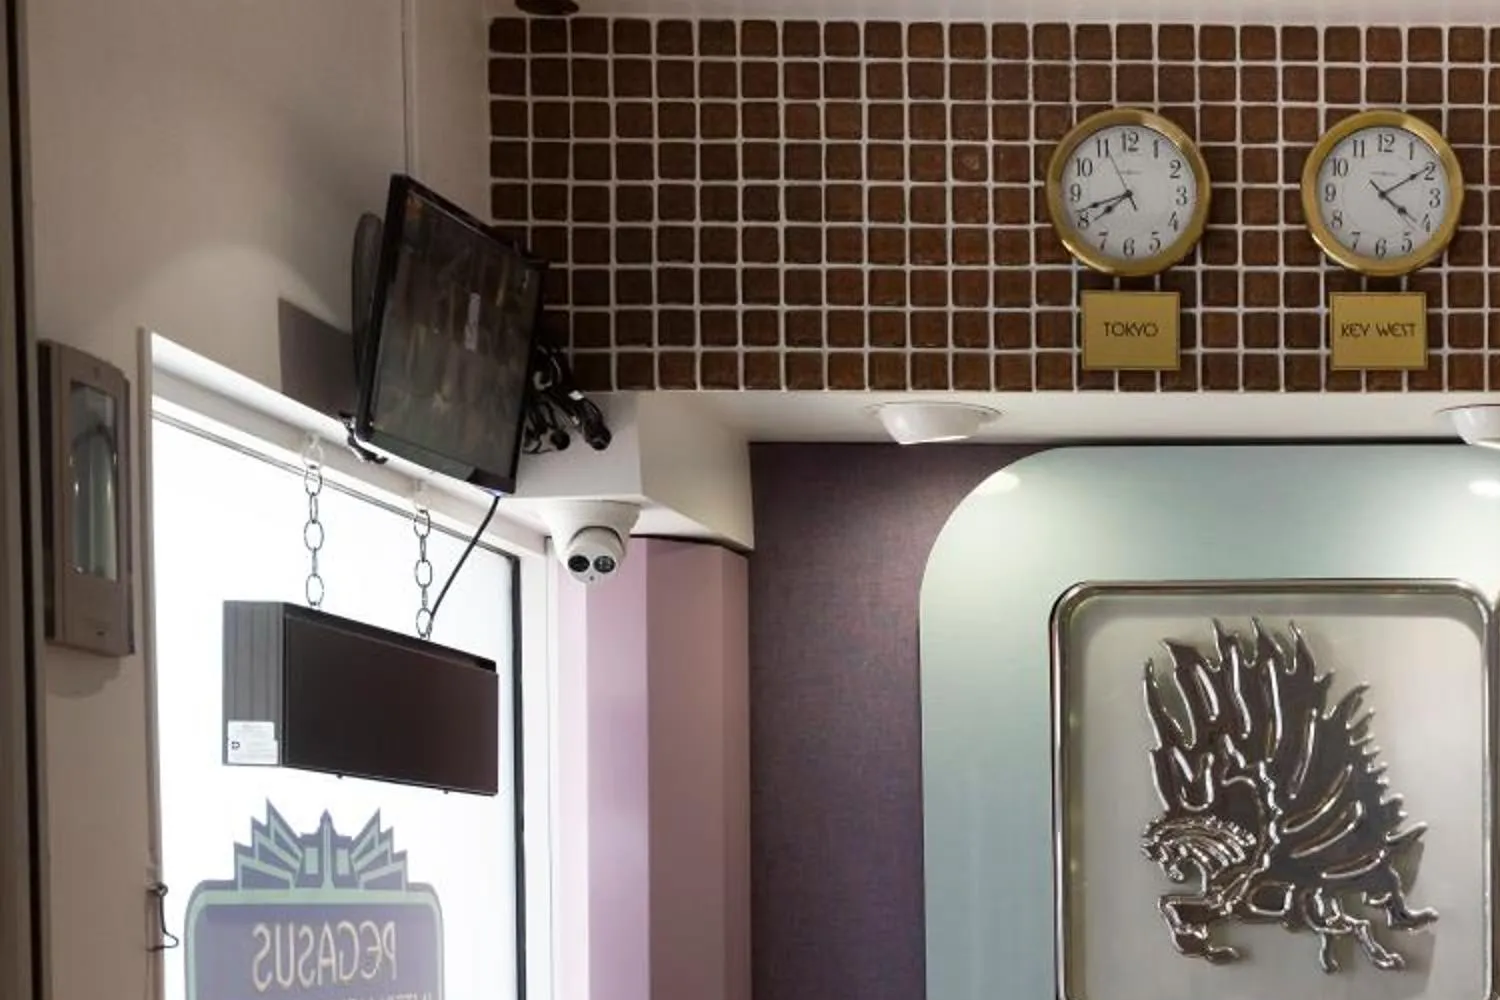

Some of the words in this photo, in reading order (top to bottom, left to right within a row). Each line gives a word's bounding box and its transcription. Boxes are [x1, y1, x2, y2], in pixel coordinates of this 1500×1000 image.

[1097, 138, 1109, 158] 11
[1122, 132, 1138, 152] 12
[1353, 140, 1365, 158] 11
[1378, 134, 1395, 152] 12
[1077, 158, 1093, 177] 10
[1170, 160, 1181, 179] 2
[1332, 158, 1348, 176] 10
[1424, 162, 1436, 181] 2
[1070, 183, 1081, 202] 9
[1176, 186, 1187, 205] 3
[1325, 184, 1336, 202] 9
[1429, 188, 1440, 208] 3
[1078, 211, 1090, 229] 8
[1168, 211, 1178, 231] 4
[1331, 211, 1342, 229] 8
[1422, 214, 1430, 232] 4
[1099, 232, 1108, 250] 7
[1123, 237, 1135, 256] 6
[1150, 232, 1161, 251] 5
[1351, 232, 1360, 249] 7
[1376, 239, 1386, 258] 6
[1402, 232, 1413, 252] 5
[1103, 321, 1159, 337] TOKYO
[1341, 323, 1370, 337] KEY
[1375, 323, 1416, 337] WEST
